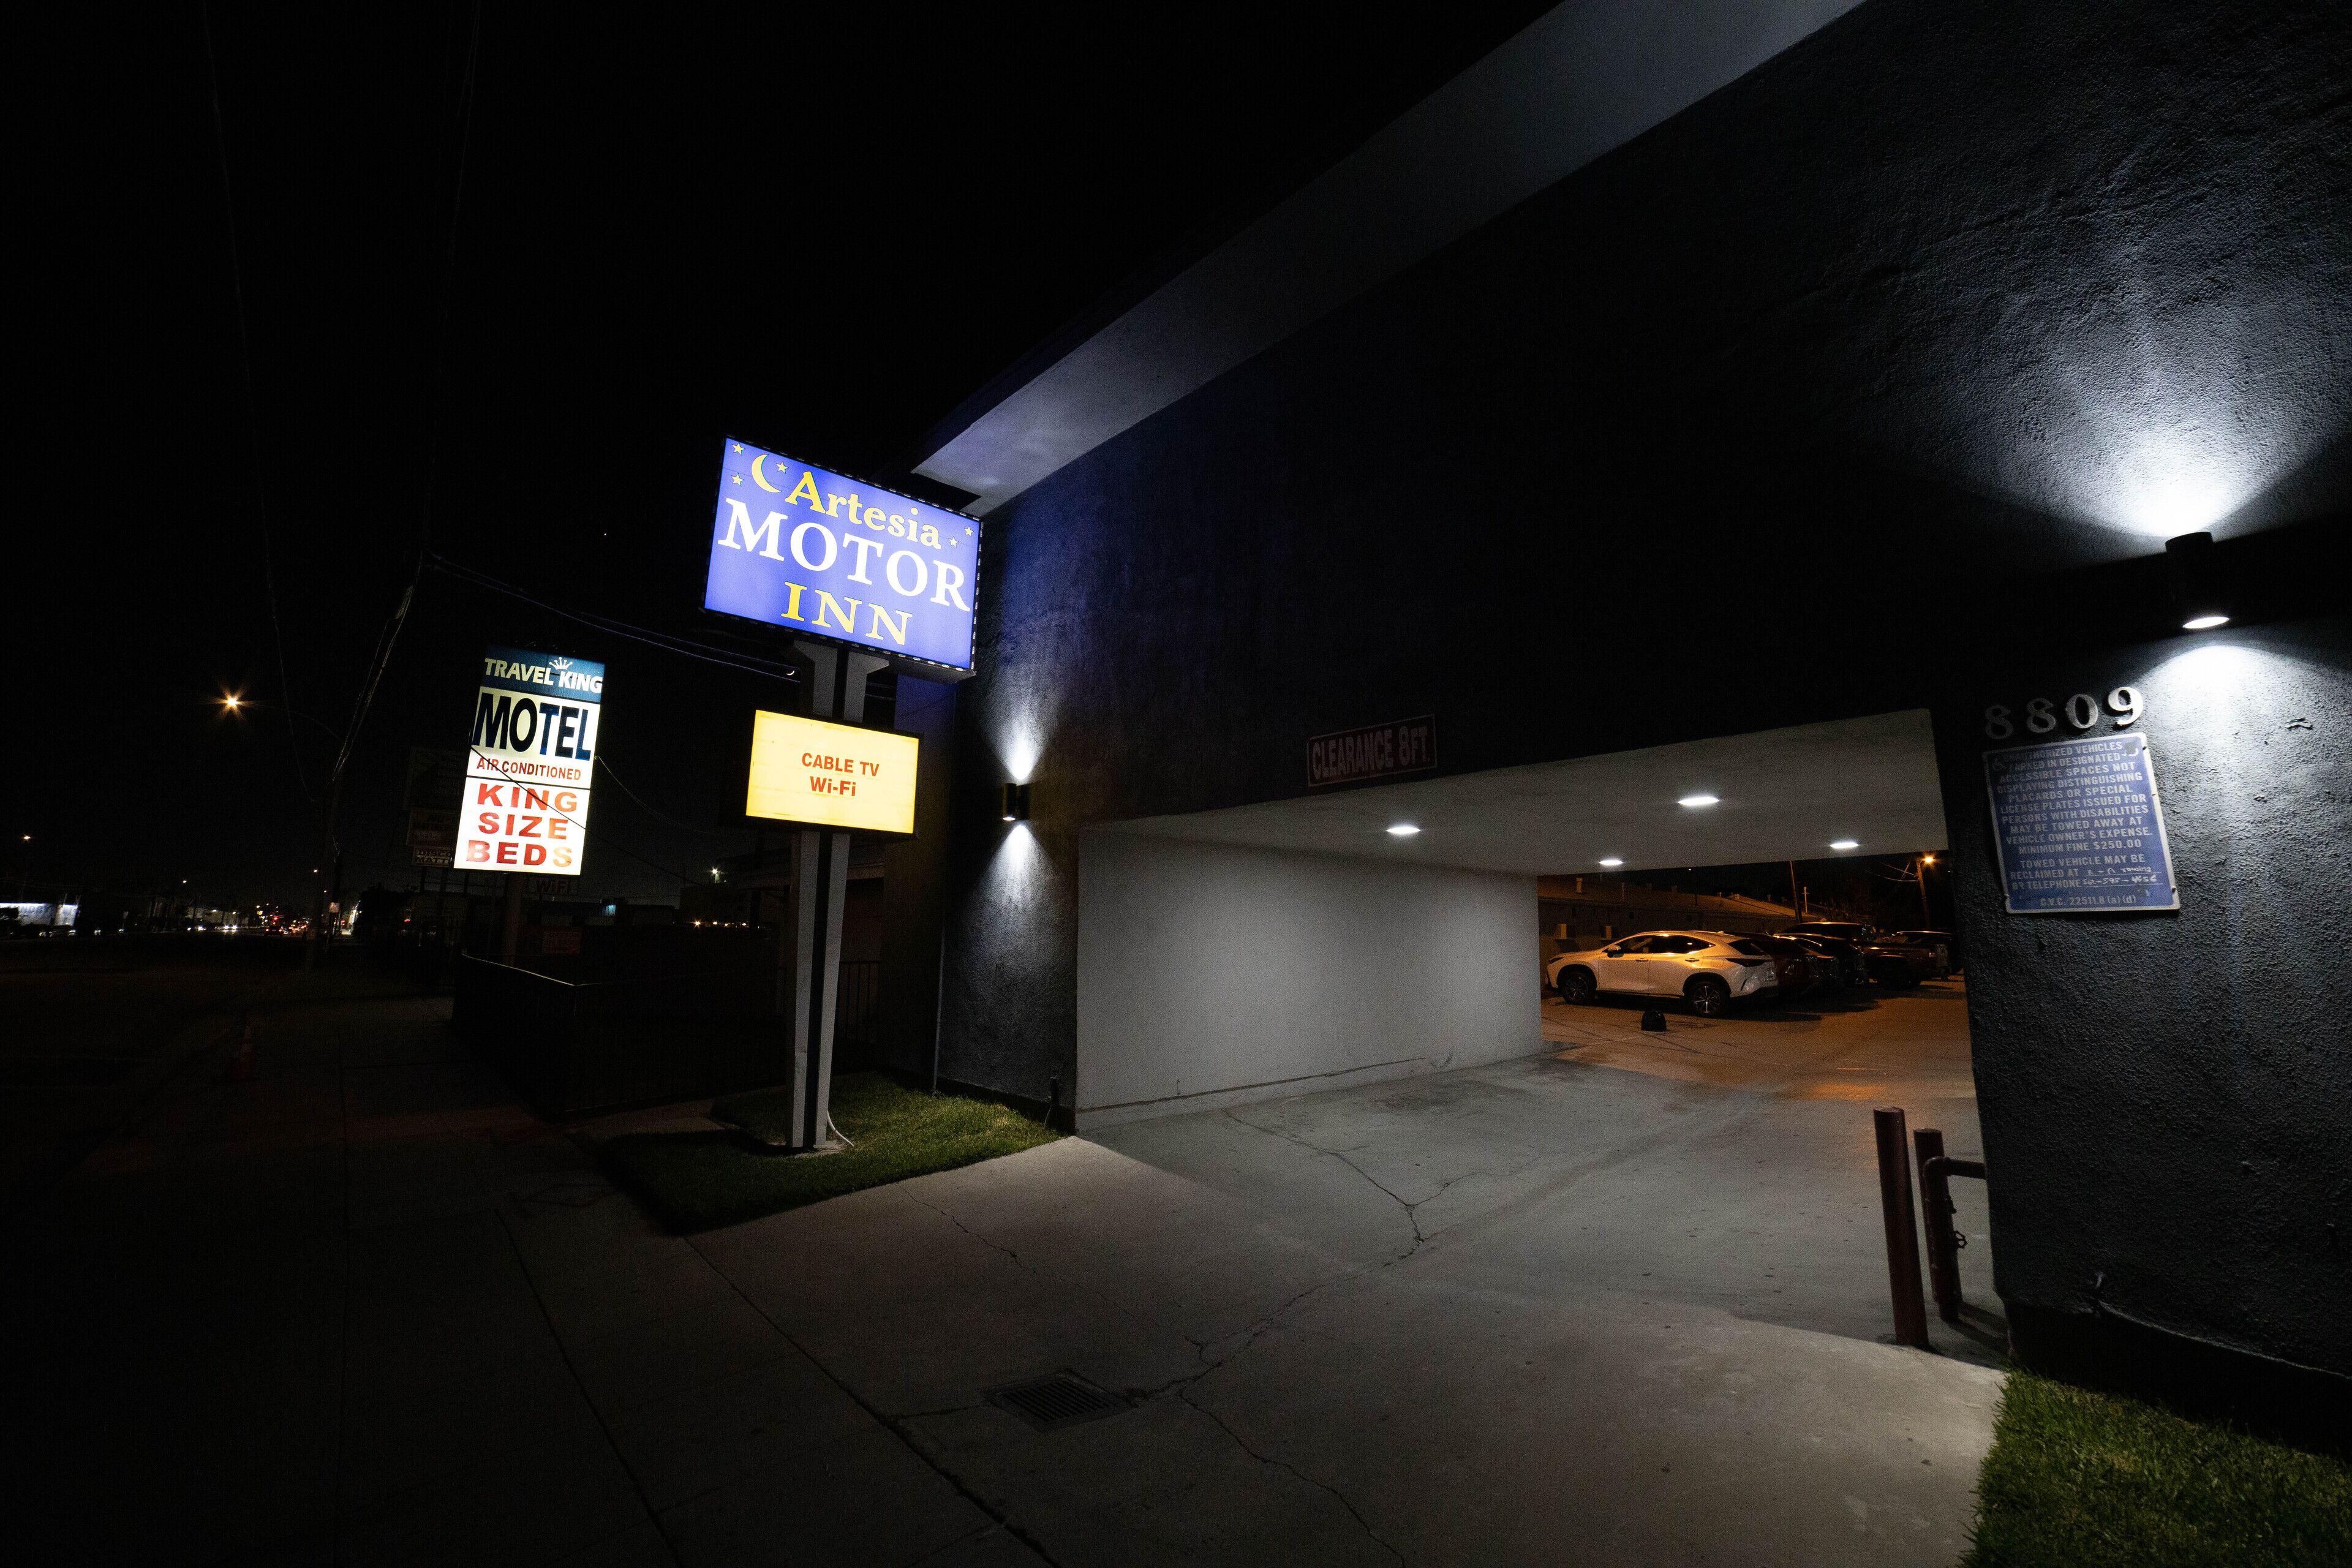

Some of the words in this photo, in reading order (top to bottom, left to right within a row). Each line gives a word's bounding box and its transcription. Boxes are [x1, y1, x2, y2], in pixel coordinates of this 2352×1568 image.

[785, 471, 941, 549] Artesia
[717, 497, 970, 611] MOTOR
[781, 581, 913, 646] INN
[484, 658, 554, 685] TRAVEL
[558, 671, 603, 693] KING
[1985, 687, 2144, 739] 8809
[472, 692, 591, 761] MOTEL
[1312, 729, 1394, 780] CLEARANCE
[2076, 741, 2123, 755] VEHICLES
[477, 757, 499, 771] AIR
[502, 761, 581, 780] CONDITIONED
[802, 752, 854, 773] CABLE
[859, 761, 880, 777] TV
[2048, 759, 2057, 767] IN
[2060, 753, 2120, 767] DESIGNATED
[1997, 780, 2055, 793] DISPLAYING
[2058, 772, 2143, 788] DISTINGUISHING
[1999, 770, 2063, 783] ACCESSIBLE
[2066, 764, 2109, 776] SPACES
[2113, 761, 2136, 772] NOT
[810, 775, 856, 796] Wi-Fi
[2008, 791, 2064, 802] PLACARDS
[2067, 788, 2081, 797] OR
[2085, 785, 2133, 796] SPECIAL
[477, 783, 578, 812] KING
[2000, 802, 2040, 814] LICENSE
[2042, 799, 2081, 810] PLATES
[2083, 796, 2122, 806] ISSUED
[2124, 794, 2147, 804] FOR
[2002, 813, 2048, 824] PERSONS
[2052, 809, 2077, 820] WITH
[2080, 805, 2149, 818] DISABILITIES
[2010, 824, 2031, 834] MAY
[2035, 823, 2048, 832] BE
[2052, 820, 2089, 831] TOWED
[2094, 817, 2124, 827] AWAY
[2129, 816, 2142, 826] AT
[478, 812, 568, 840] SIZE
[2006, 833, 2045, 845] VEHICLE
[2048, 830, 2096, 842] OWNER'S
[2100, 827, 2153, 839] EXPENSE.
[466, 840, 573, 867] BEDS
[2019, 843, 2064, 854] MINIMUM
[2067, 842, 2090, 851] FINE
[2094, 839, 2142, 850] $250.00
[2020, 859, 2056, 869] TOWED
[2059, 856, 2101, 867] VEHICLE
[2104, 854, 2127, 864] MAY
[2131, 853, 2145, 863] BE
[2010, 869, 2064, 880] RECLAIMED
[2068, 868, 2079, 877] AT
[2027, 879, 2082, 889] TELEPHONE
[2040, 897, 2067, 906] C.V.C.
